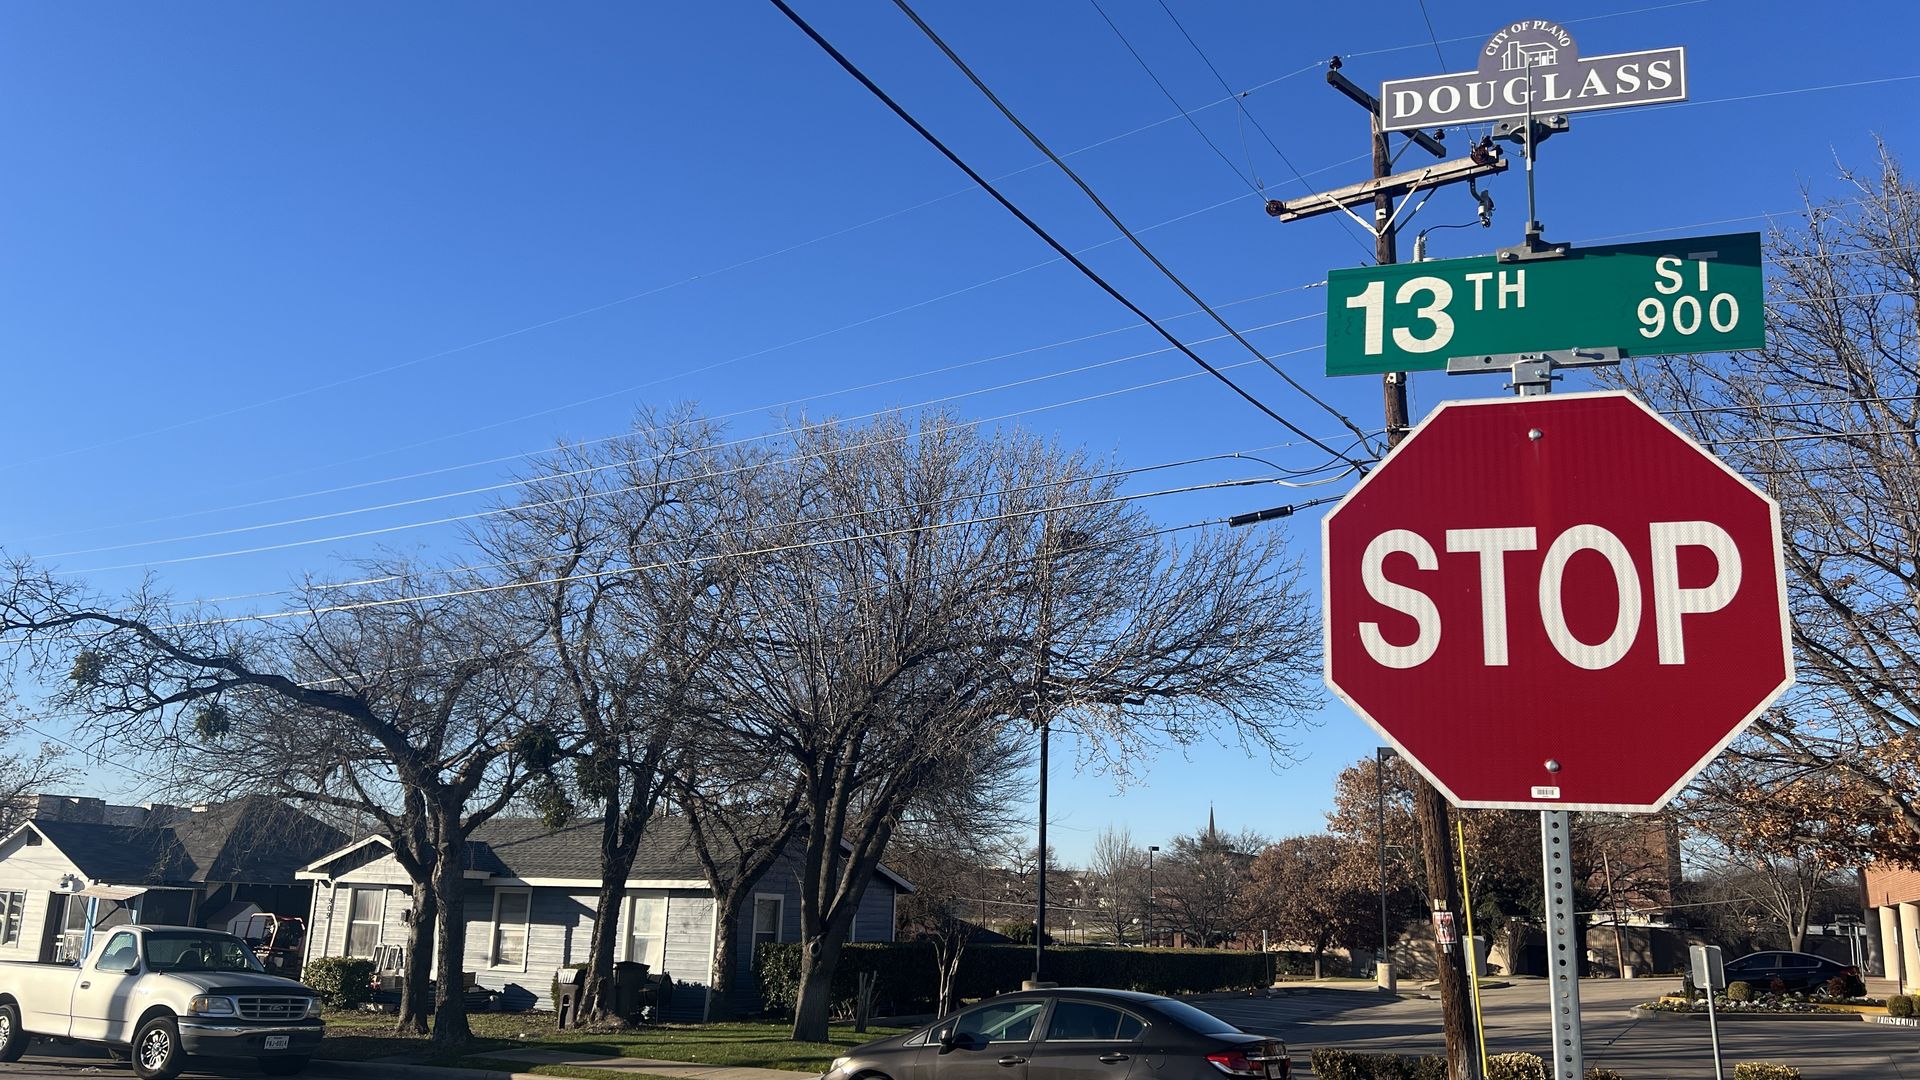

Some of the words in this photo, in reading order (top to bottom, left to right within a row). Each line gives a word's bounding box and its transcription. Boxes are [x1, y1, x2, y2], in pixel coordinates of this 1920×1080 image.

[1486, 29, 1509, 56] CITY
[1511, 21, 1530, 33] OF
[1533, 20, 1571, 47] PLANO
[1392, 59, 1673, 119] DOUGLASS
[1654, 251, 1719, 295] ST
[1637, 292, 1740, 339] 900
[1358, 520, 1743, 670] STOP
